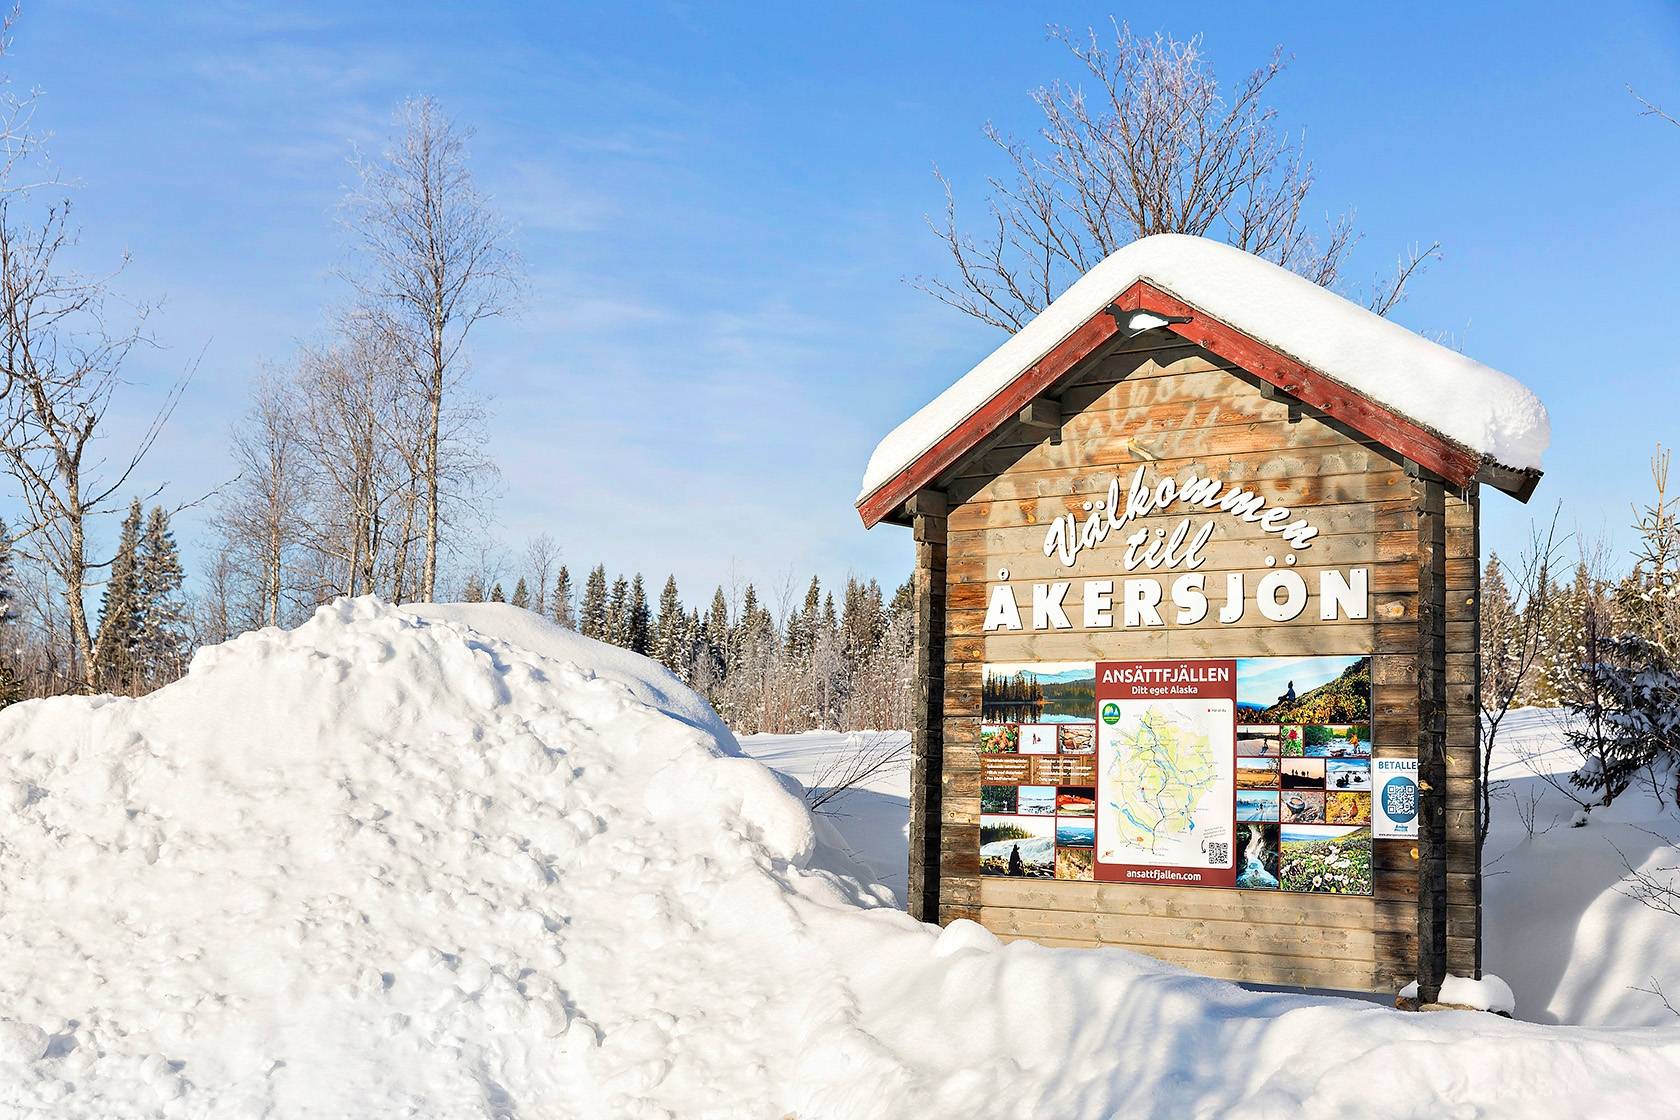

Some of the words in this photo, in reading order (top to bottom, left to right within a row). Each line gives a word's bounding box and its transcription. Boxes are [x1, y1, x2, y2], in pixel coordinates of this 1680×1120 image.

[1043, 464, 1319, 567] Välkommen
[1122, 519, 1216, 571] till
[982, 553, 1370, 631] ÅKERSJÖN
[1102, 664, 1229, 684] ANSÄTTFJÄLLEN
[1131, 685, 1148, 695] Ditt
[1149, 686, 1168, 696] eget
[1170, 685, 1198, 694] Alaska
[1378, 761, 1419, 770] BETALLE
[1126, 869, 1202, 881] ansattfjallen.com
